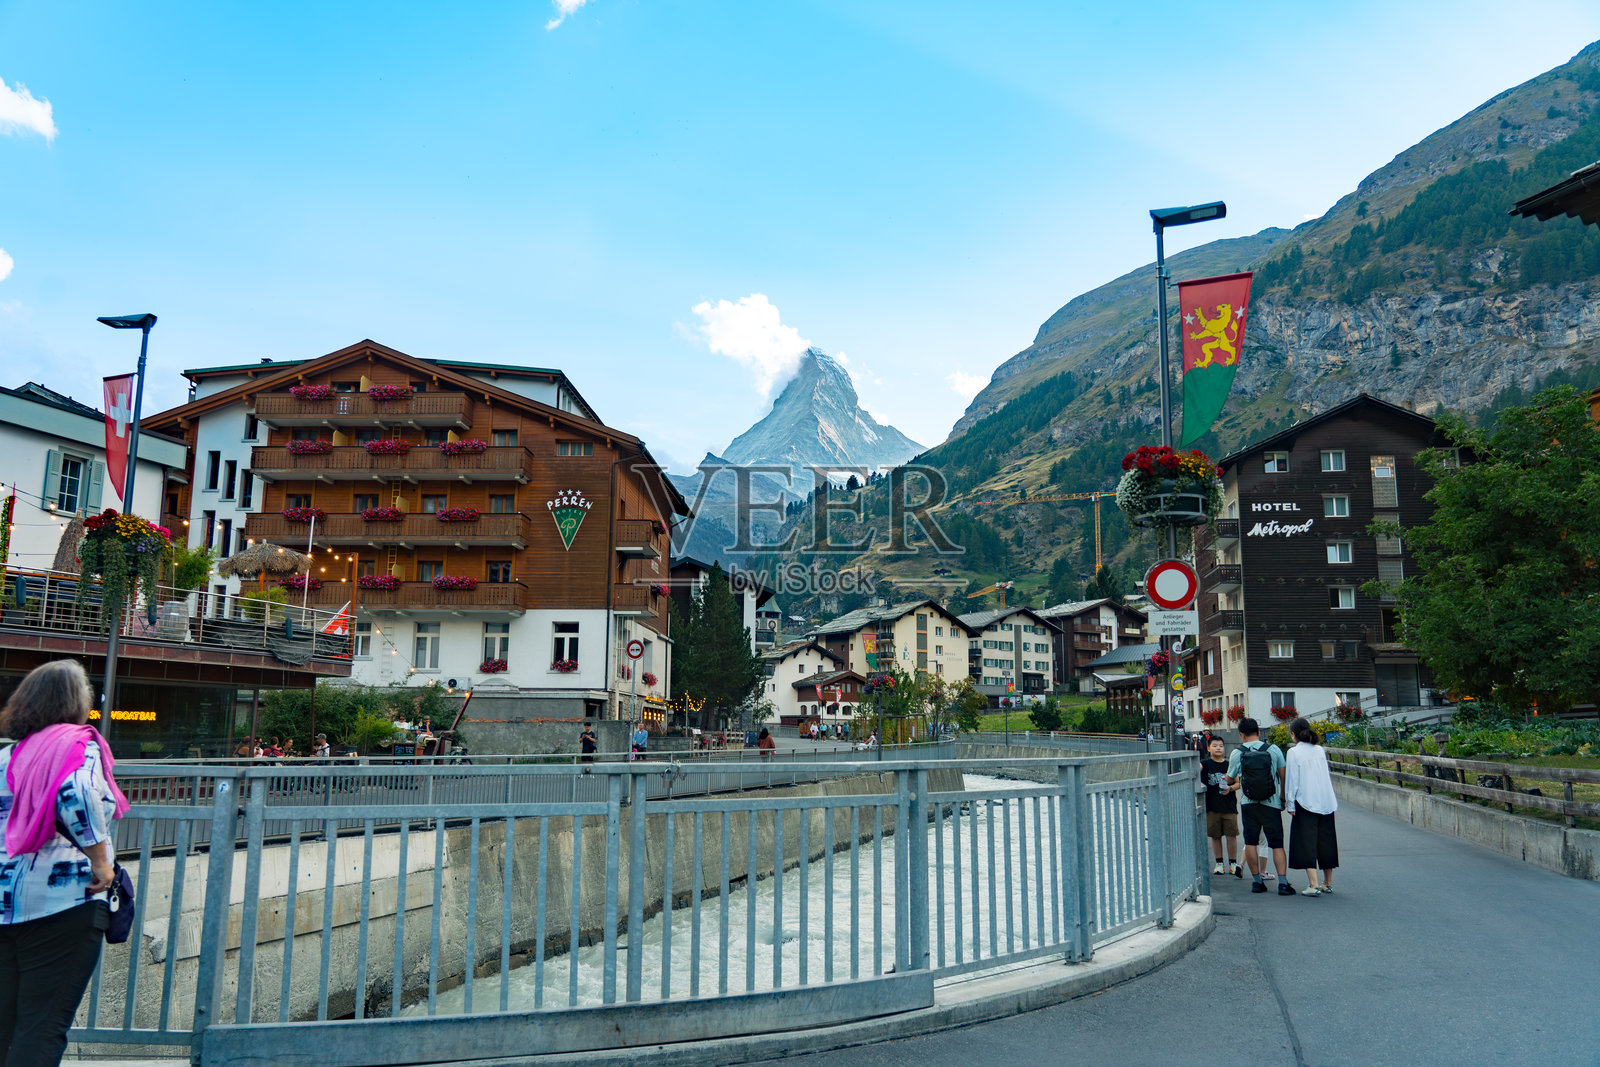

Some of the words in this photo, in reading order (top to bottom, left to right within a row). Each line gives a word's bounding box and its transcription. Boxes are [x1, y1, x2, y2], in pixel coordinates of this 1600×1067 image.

[546, 496, 593, 510] PERREN
[1252, 503, 1300, 512] HOTEL
[1247, 518, 1313, 537] Metropol
